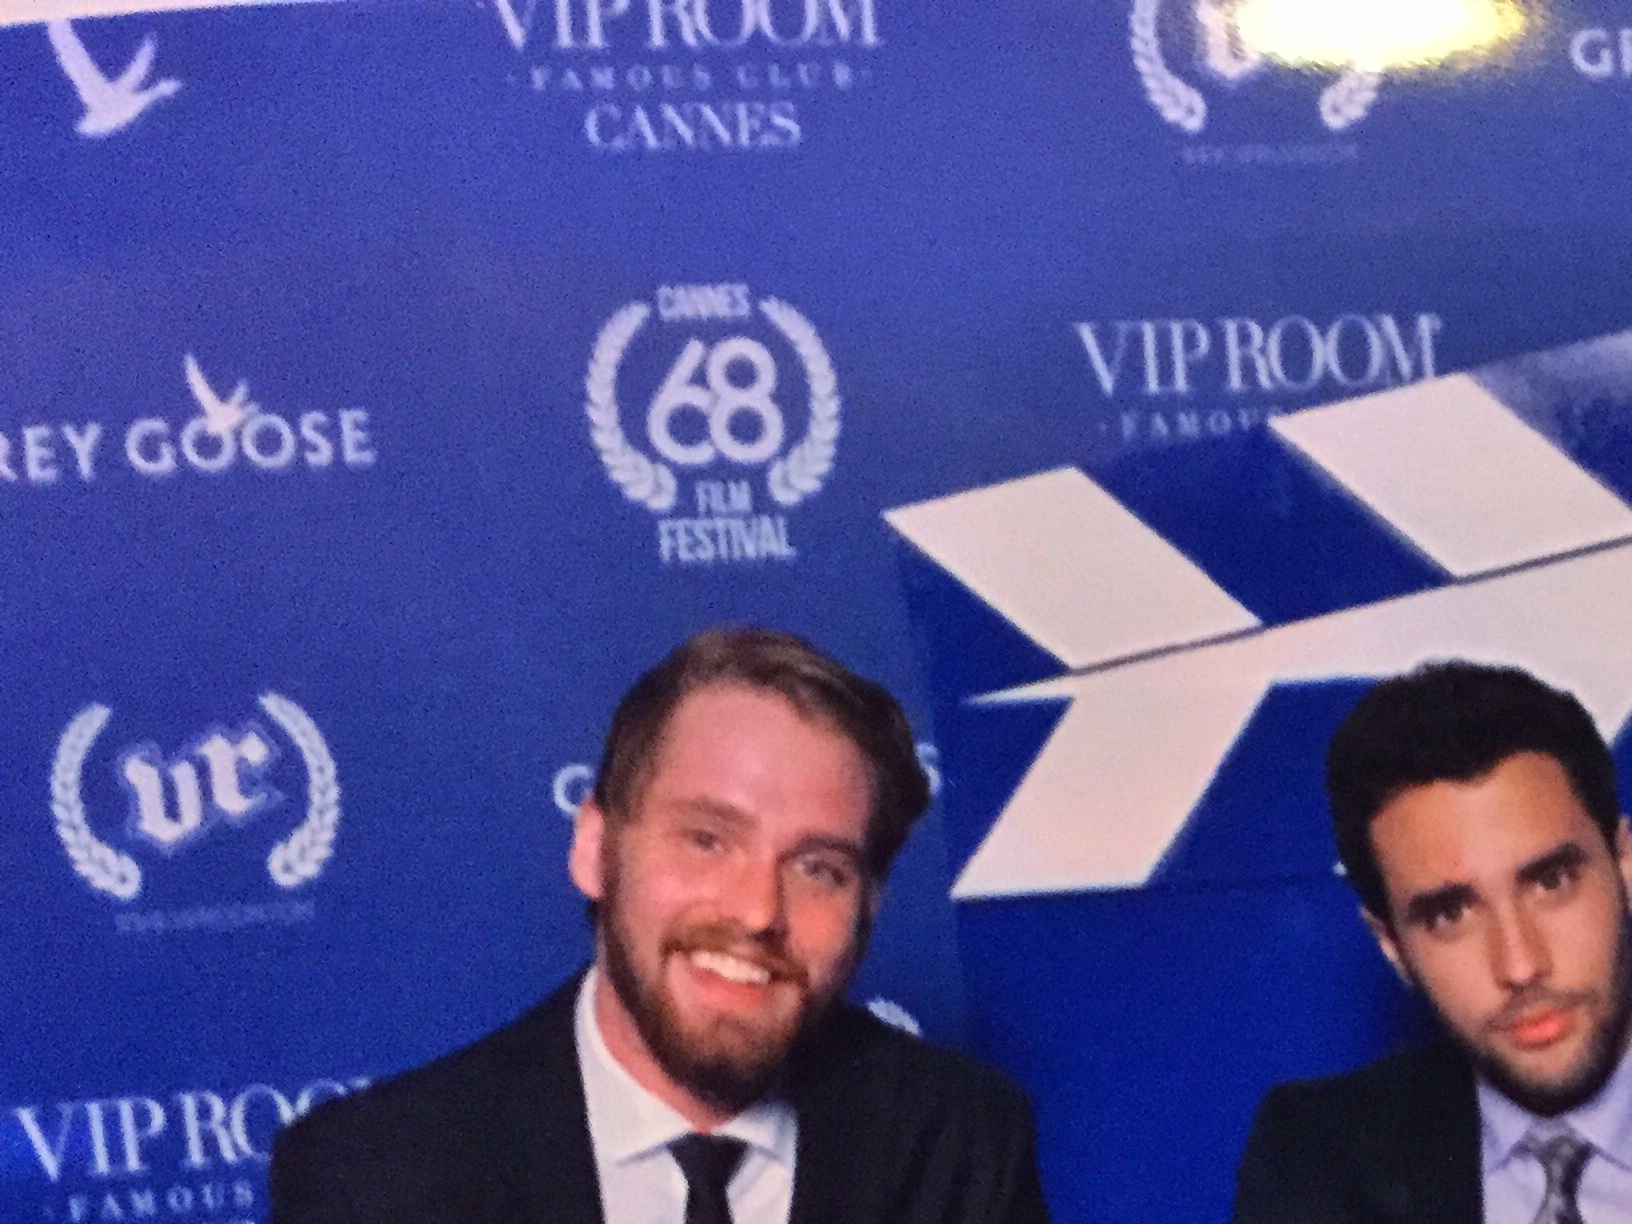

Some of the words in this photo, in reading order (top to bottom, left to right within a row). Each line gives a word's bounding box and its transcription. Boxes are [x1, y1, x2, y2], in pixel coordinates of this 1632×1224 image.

[530, 64, 711, 92] FAMOUS
[736, 60, 853, 90] CLUB
[584, 102, 801, 152] CANNES
[656, 282, 749, 322] CANNES
[1072, 320, 1211, 396] VIP
[1217, 311, 1442, 393] ROOM
[647, 336, 785, 465] 68
[124, 408, 378, 476] GOOSE
[696, 480, 751, 512] FILM
[657, 515, 798, 562] FESTIVAL
[15, 1097, 167, 1183] VIP
[175, 1075, 373, 1170] RO
[69, 1180, 256, 1222] FAMOUS
